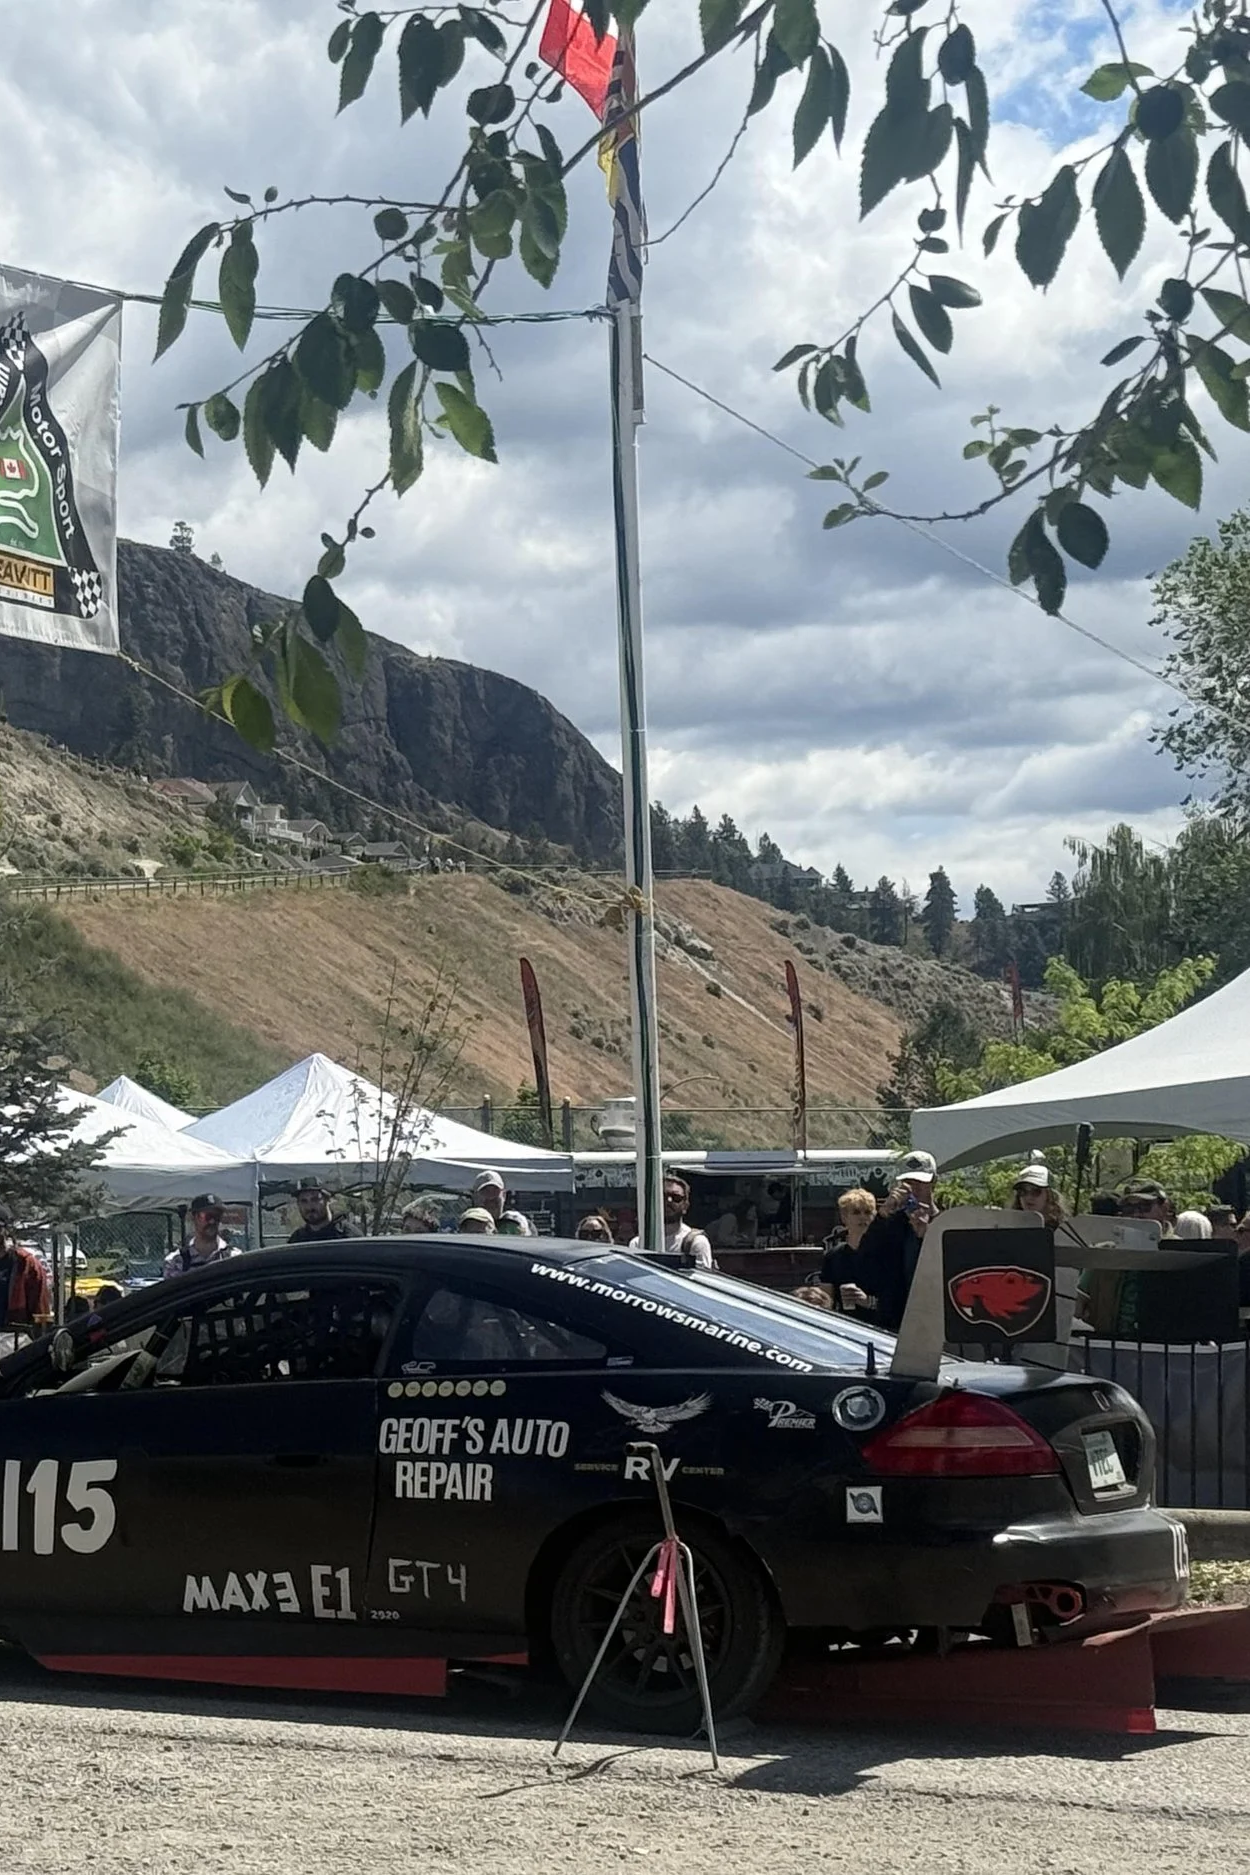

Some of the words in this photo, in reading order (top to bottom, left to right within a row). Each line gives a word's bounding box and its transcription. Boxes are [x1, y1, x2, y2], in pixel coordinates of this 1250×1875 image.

[29, 381, 62, 458] Motor
[54, 463, 76, 541] Sport
[530, 1262, 813, 1374] www.morrowsmarine.com
[379, 1416, 485, 1455] GEOFF'S
[489, 1418, 570, 1458] AUTO
[623, 1456, 681, 1482] RV
[2, 1459, 117, 1555] 115
[395, 1460, 494, 1501] REPAIR
